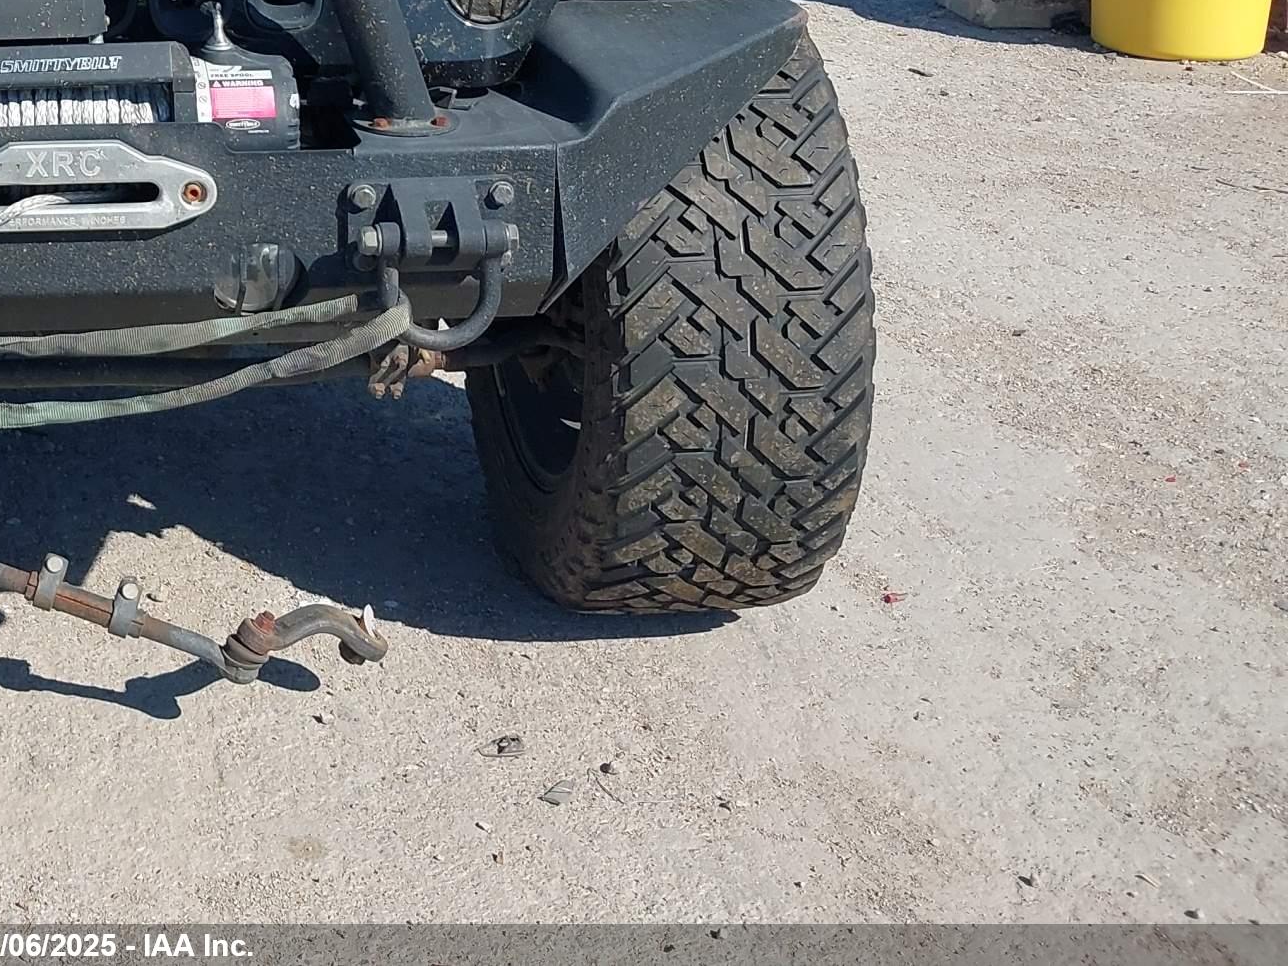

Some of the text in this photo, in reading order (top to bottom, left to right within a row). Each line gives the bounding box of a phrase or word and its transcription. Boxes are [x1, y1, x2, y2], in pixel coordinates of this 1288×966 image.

[0, 55, 123, 74] SMITTYBILT
[222, 79, 264, 87] WARNING
[25, 150, 103, 178] XRC
[9, 216, 76, 229] ERFORMANCE
